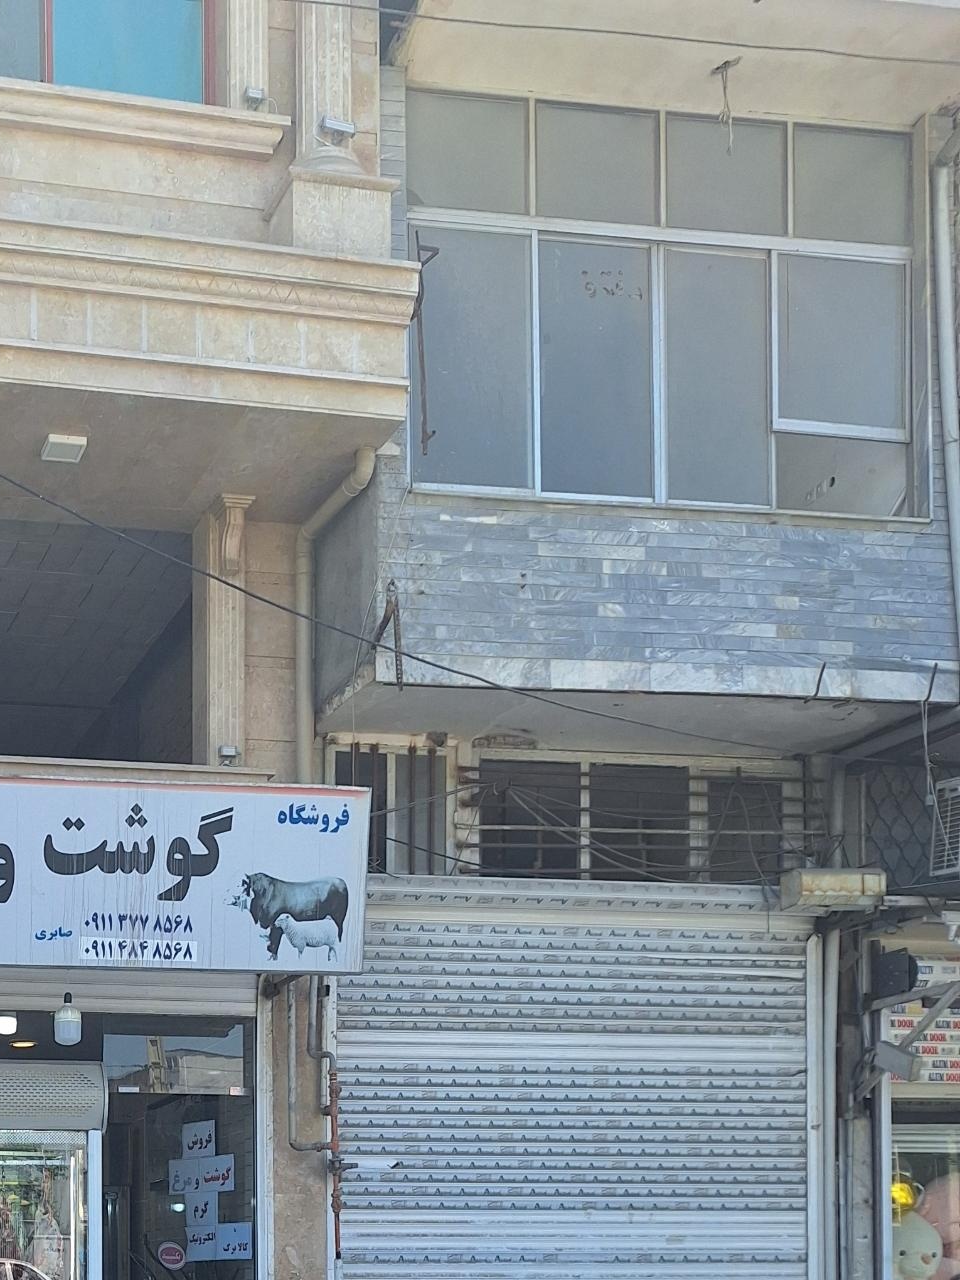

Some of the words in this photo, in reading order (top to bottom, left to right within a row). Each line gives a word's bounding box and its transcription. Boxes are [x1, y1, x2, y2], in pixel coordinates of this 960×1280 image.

[277, 803, 350, 833] فروشگاه
[43, 803, 235, 901] گوشت
[34, 926, 73, 941] صابری
[187, 1129, 213, 1151] فروش
[193, 1177, 200, 1190] و
[203, 1166, 231, 1186] گوشت
[193, 1200, 209, 1219] گرم
